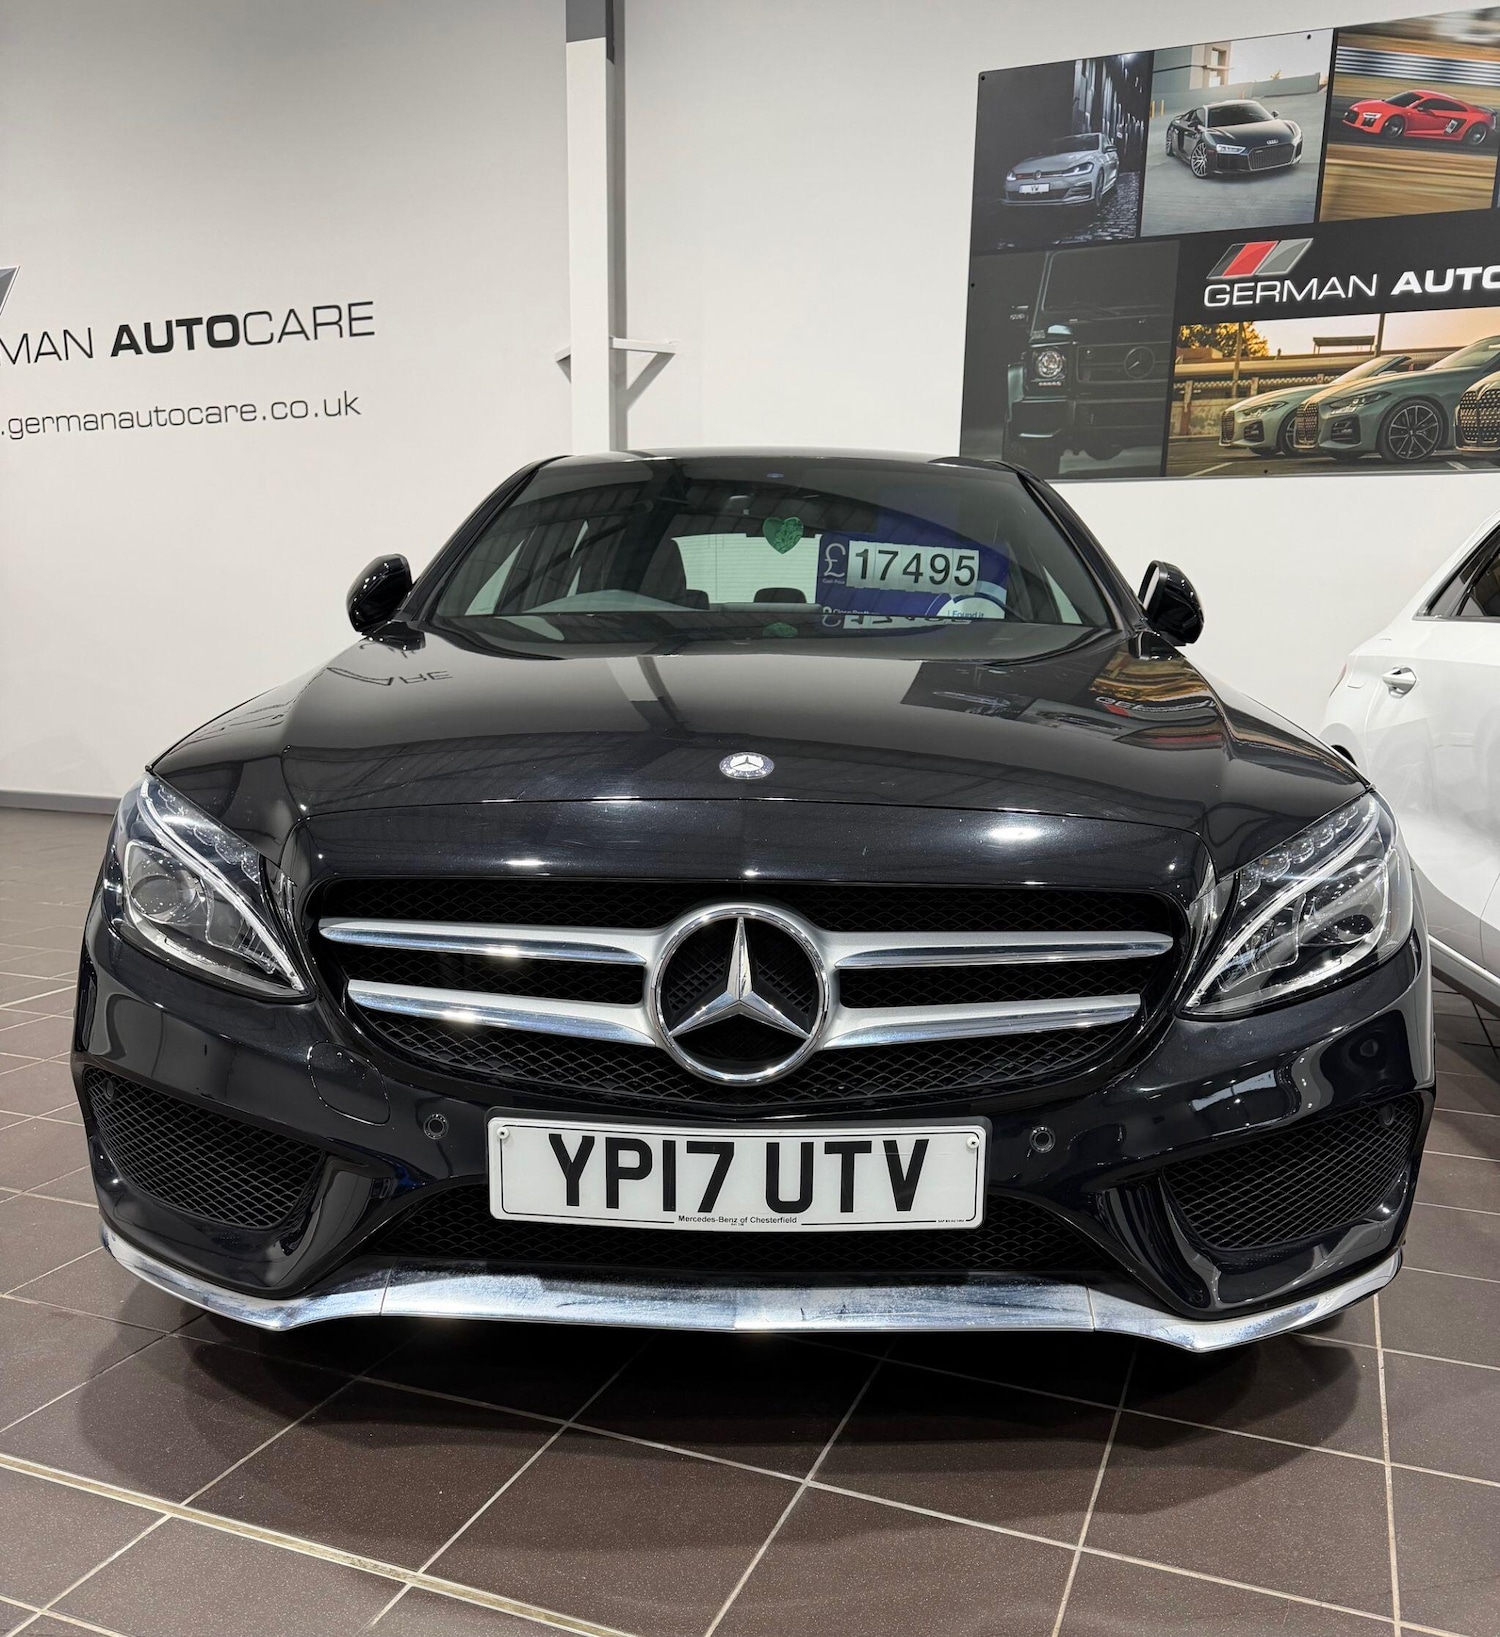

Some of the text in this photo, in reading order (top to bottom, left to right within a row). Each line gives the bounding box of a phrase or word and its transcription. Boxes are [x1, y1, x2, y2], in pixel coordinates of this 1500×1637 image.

[1203, 273, 1379, 308] GERMAN
[110, 301, 375, 357] AUTOCARE
[855, 548, 976, 586] 17495
[548, 1133, 930, 1213] YP17 UTV
[678, 1215, 738, 1223] Mercedes-Benz
[749, 1216, 798, 1224] Chesterfield
